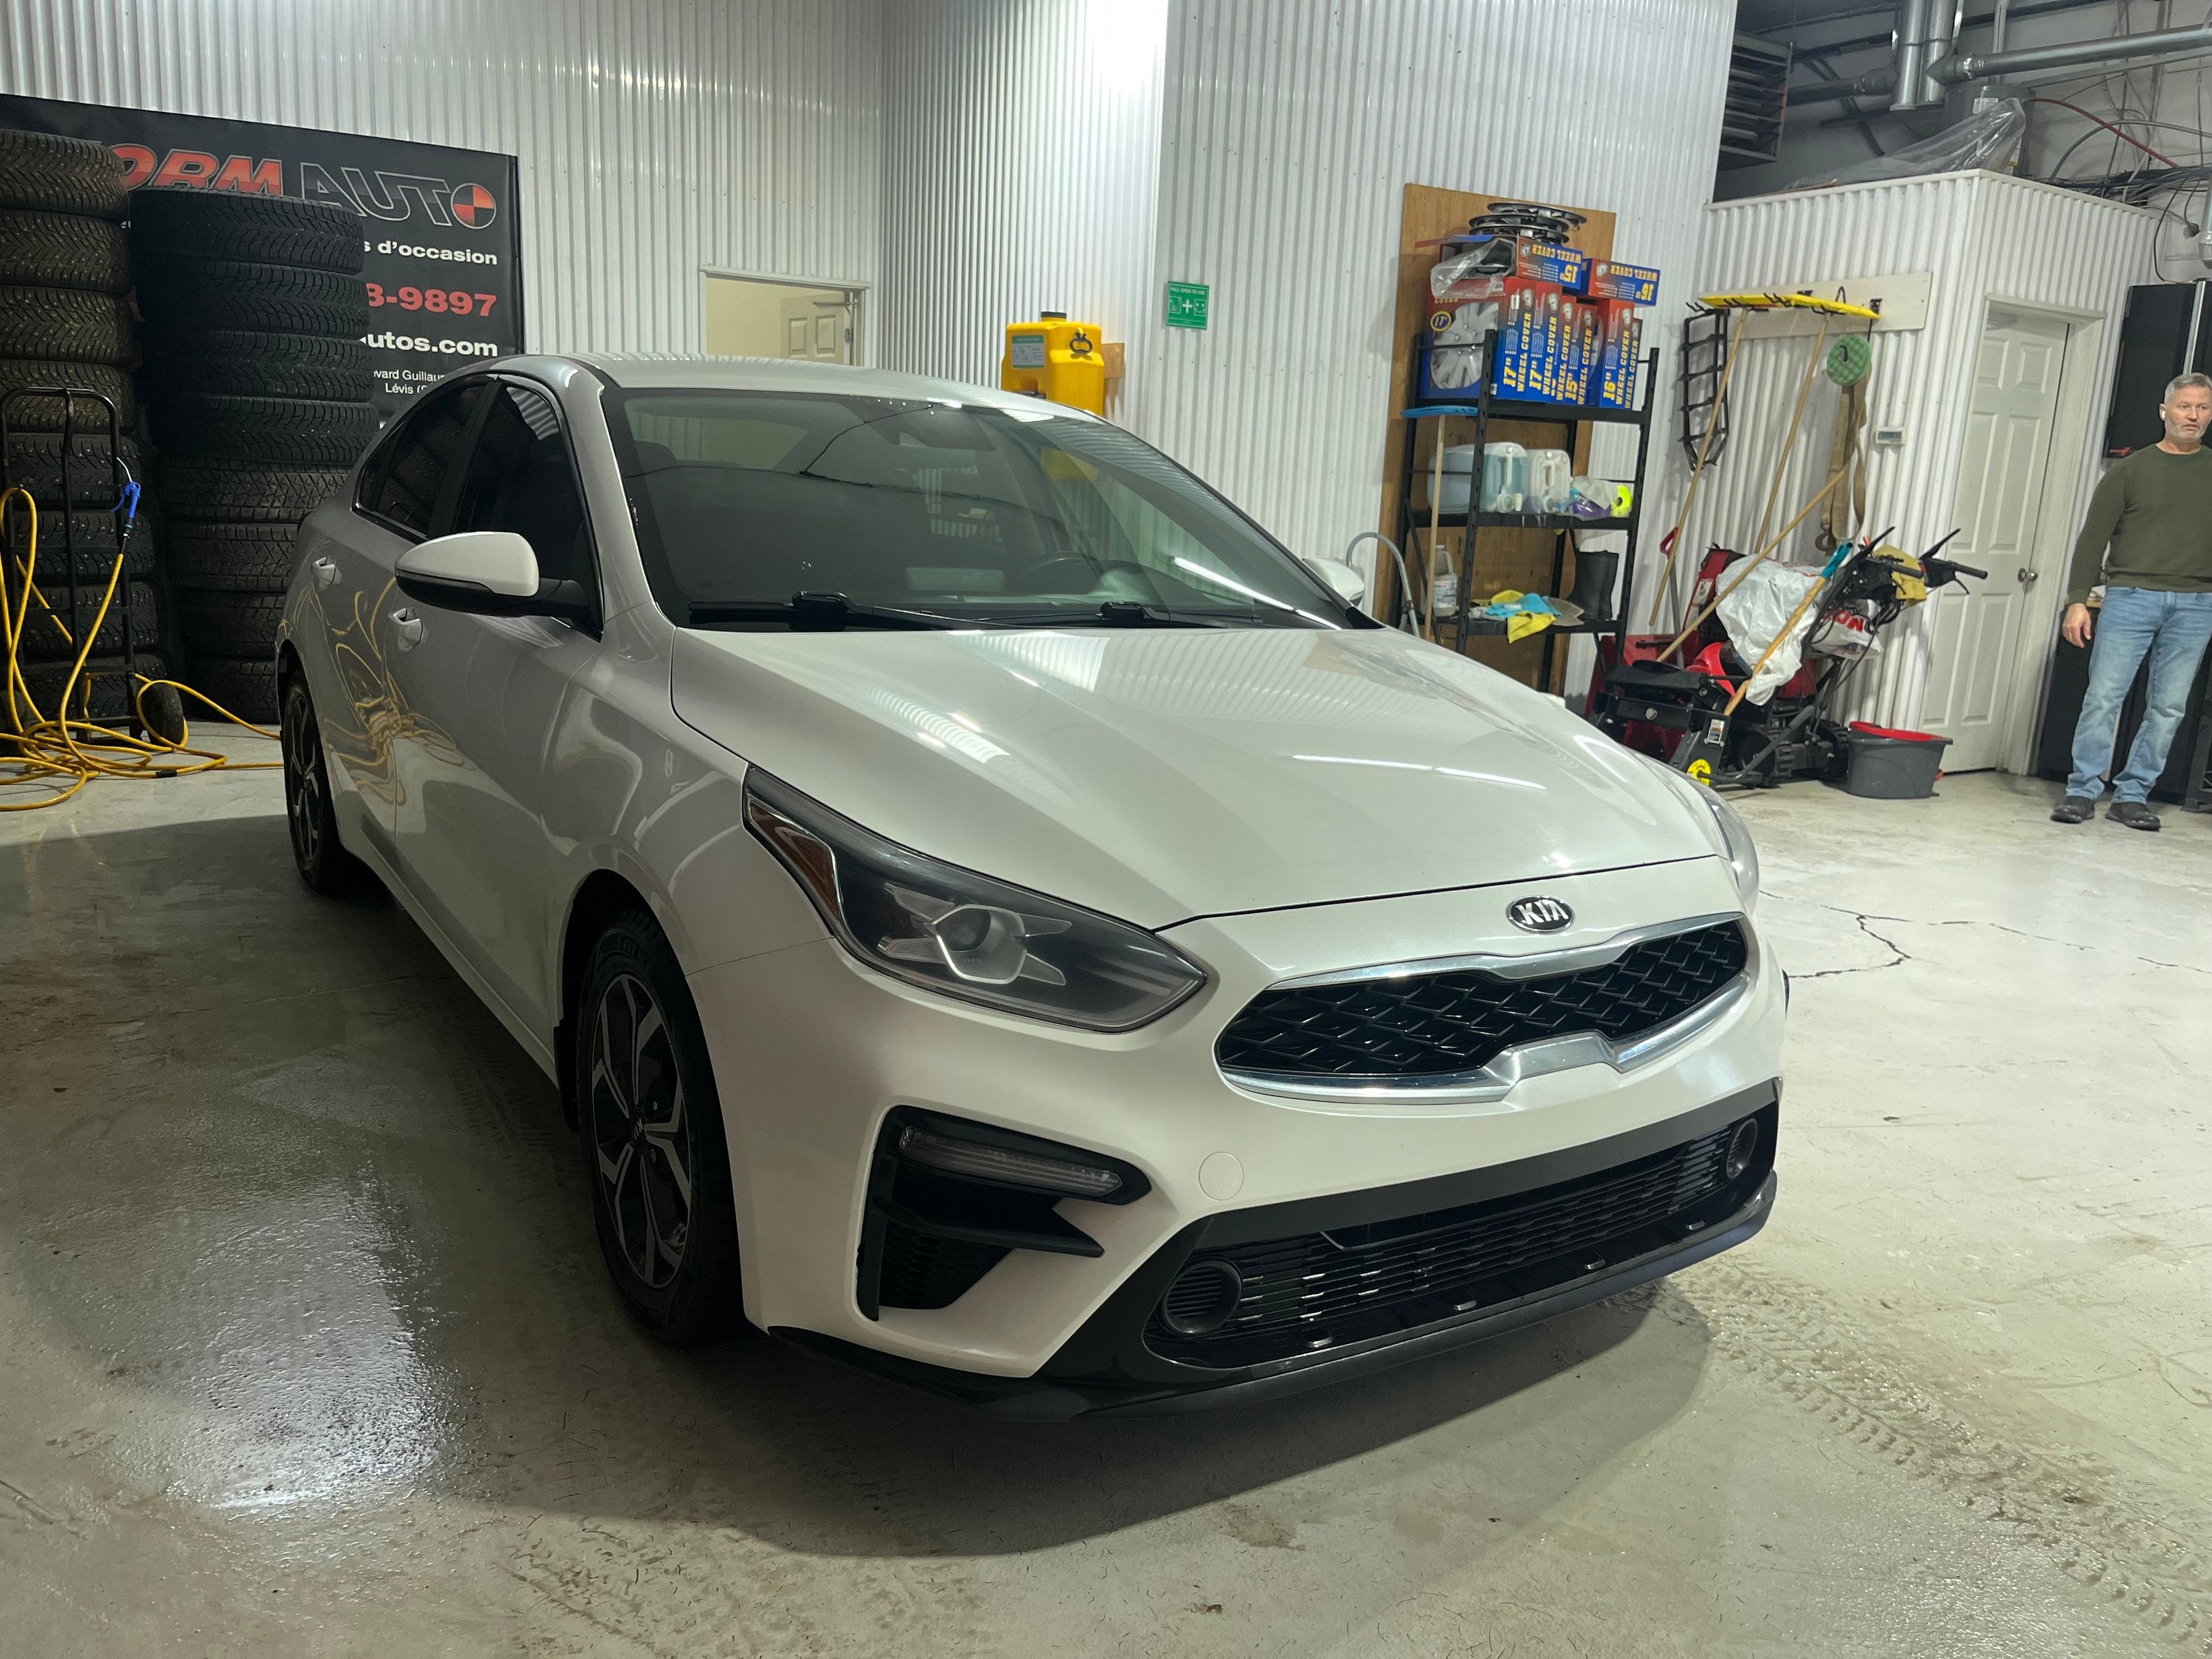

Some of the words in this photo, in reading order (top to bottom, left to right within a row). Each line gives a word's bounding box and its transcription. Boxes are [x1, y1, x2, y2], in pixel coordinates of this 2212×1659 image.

[378, 240, 498, 265] d'occasion
[1532, 243, 1556, 258] COVER
[1556, 250, 1582, 264] WHEEL
[1610, 264, 1633, 276] COVER
[1634, 270, 1658, 283] WHEEL
[1521, 312, 1532, 351] COVER
[1547, 316, 1558, 354] COVER
[1561, 325, 1572, 361] COVER
[1581, 328, 1592, 366] COVER
[1620, 330, 1630, 366] COVER
[1517, 353, 1528, 392] WHEEL
[1629, 340, 1639, 373] COVER
[385, 382, 414, 395] Lévis
[1542, 356, 1554, 395] WHEEL
[1556, 363, 1567, 401] WHEEL
[1577, 368, 1588, 405] WHEEL
[1615, 368, 1626, 405] WHEEL
[1624, 374, 1635, 409] WHEEL
[1515, 899, 1569, 925] KIA
